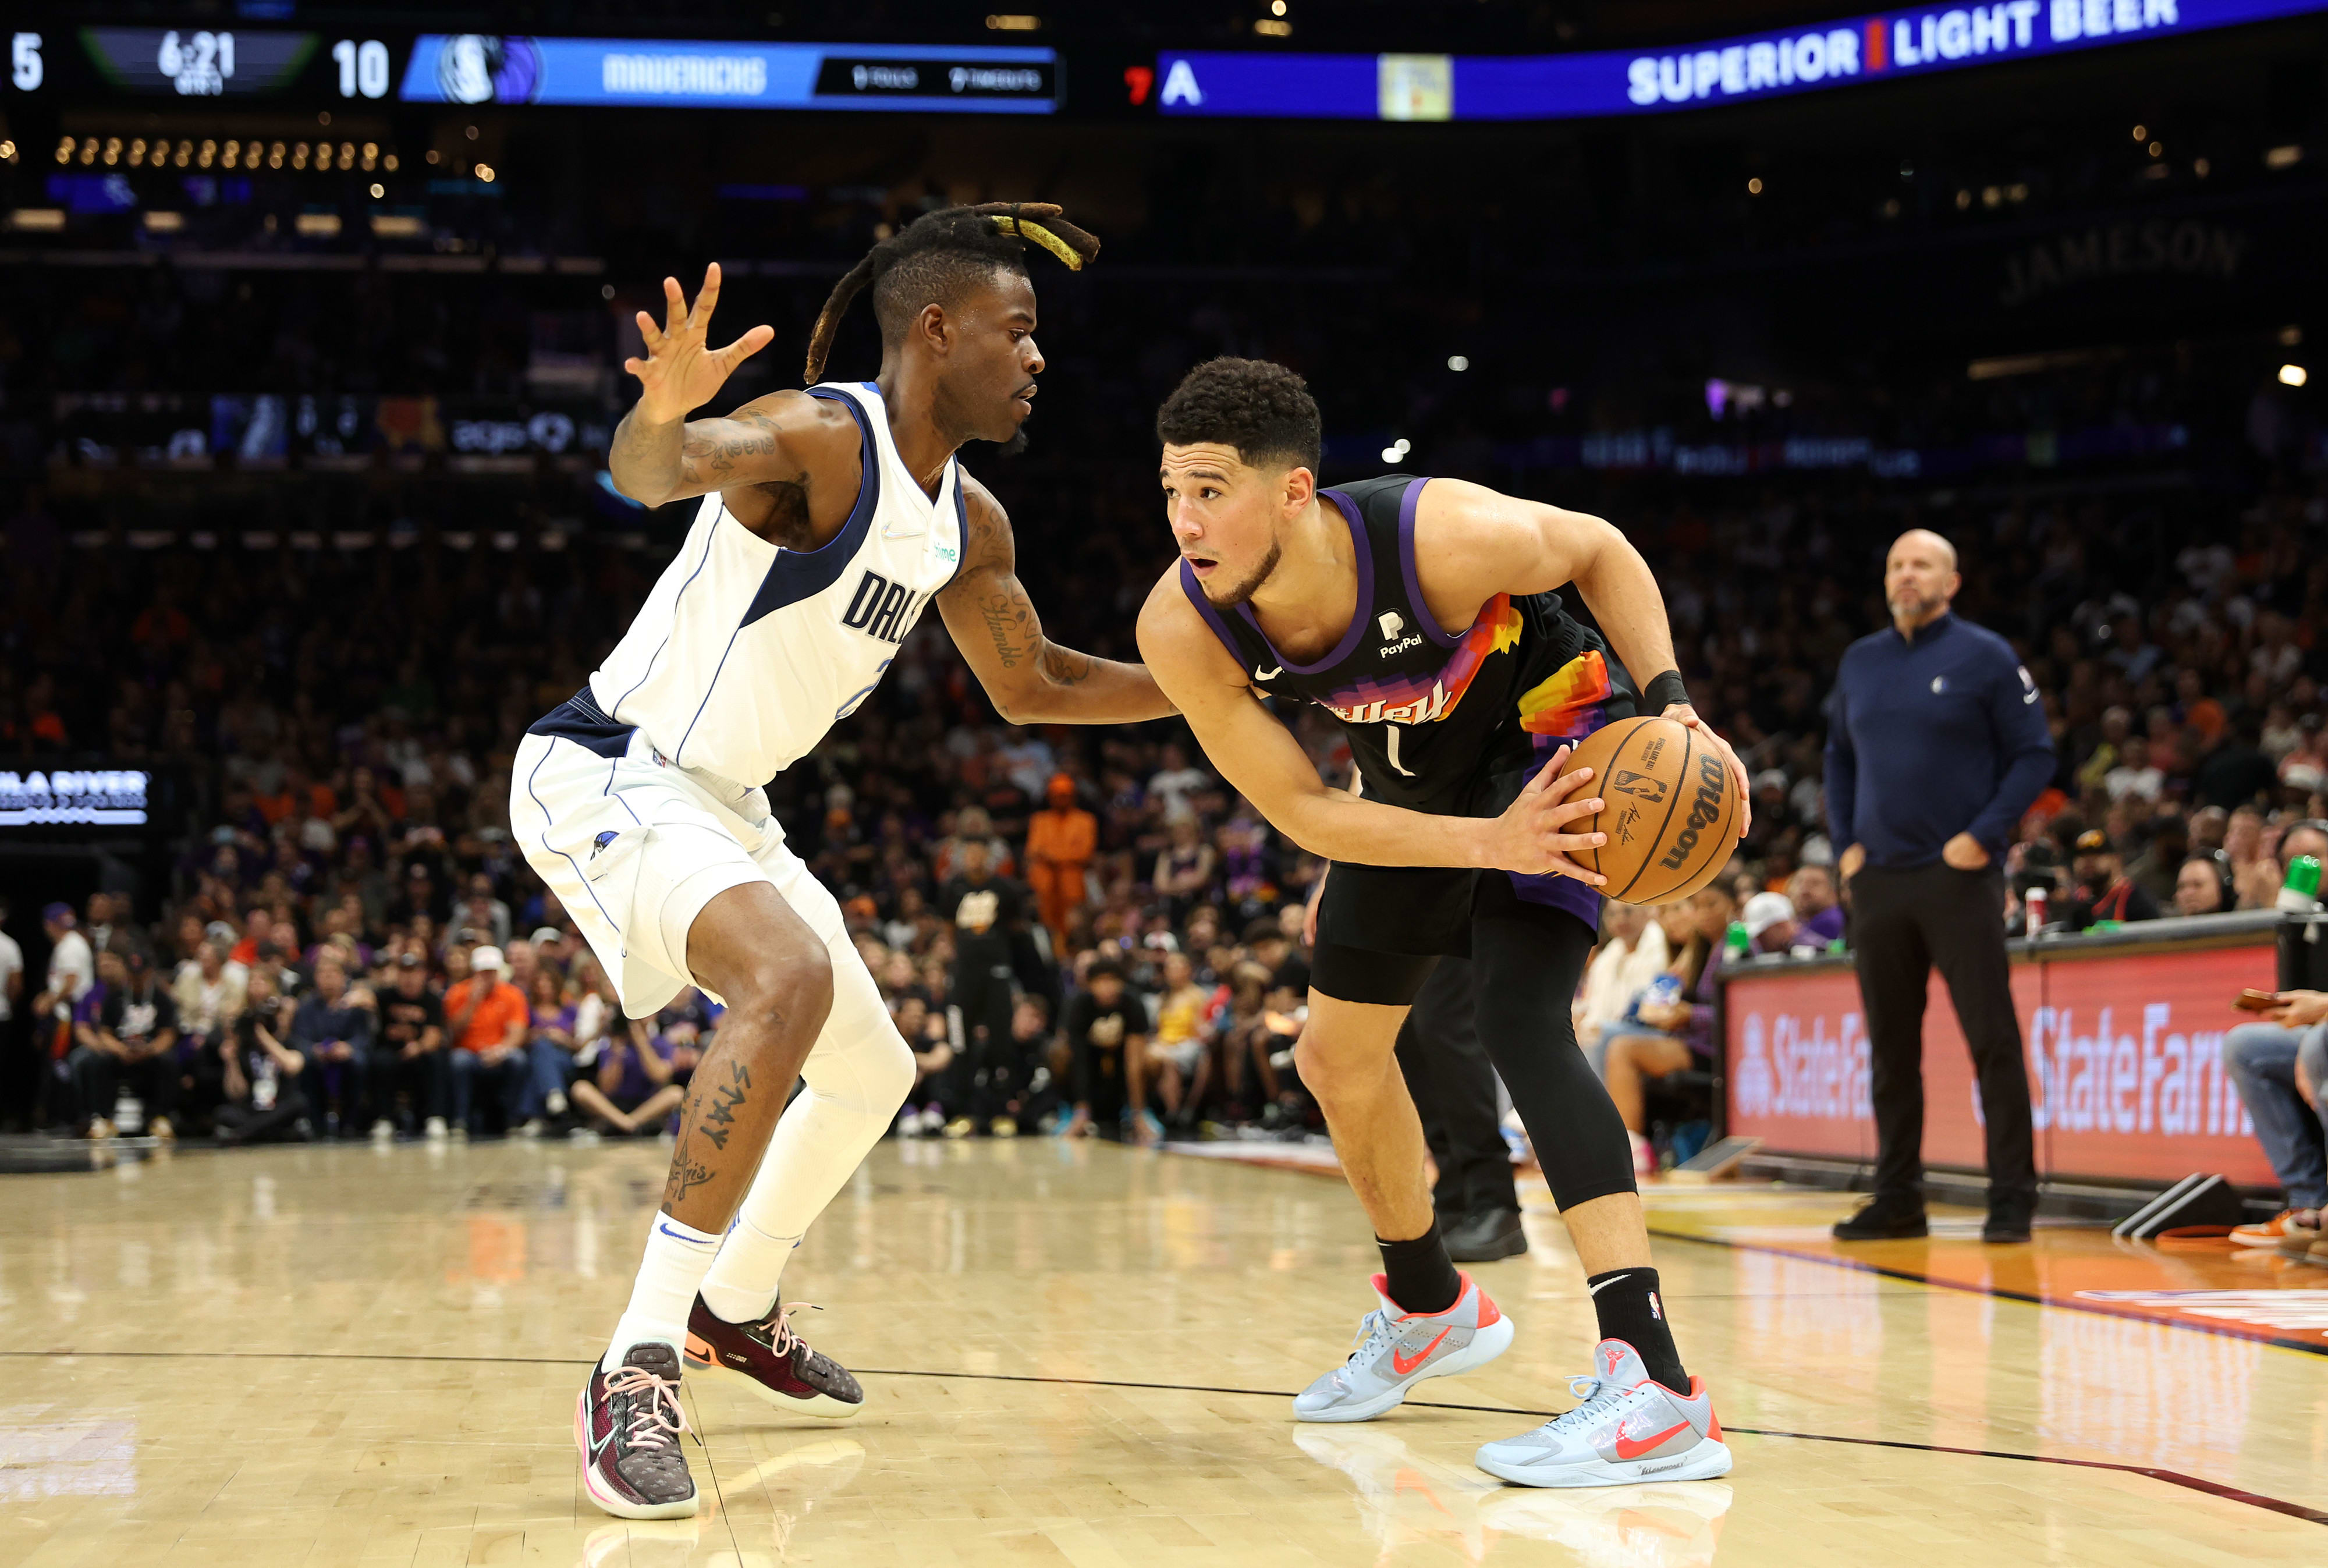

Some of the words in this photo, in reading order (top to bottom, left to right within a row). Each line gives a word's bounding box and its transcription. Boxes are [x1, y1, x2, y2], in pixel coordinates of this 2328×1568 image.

[12, 32, 43, 91] 5
[158, 30, 235, 78] 6:21
[332, 40, 389, 98] 10
[1627, 28, 1859, 106] SUPERIOR
[1894, 0, 2041, 67] LIGHT
[2050, 0, 2179, 42] BEER
[1998, 217, 2247, 308] JAMESON
[977, 594, 1023, 669] Humble
[1380, 634, 1422, 659] PayPal
[1333, 679, 1453, 725] lley
[1386, 723, 1416, 776] 1
[1659, 754, 1724, 870] Wilson
[1773, 1012, 1873, 1118] StateFa
